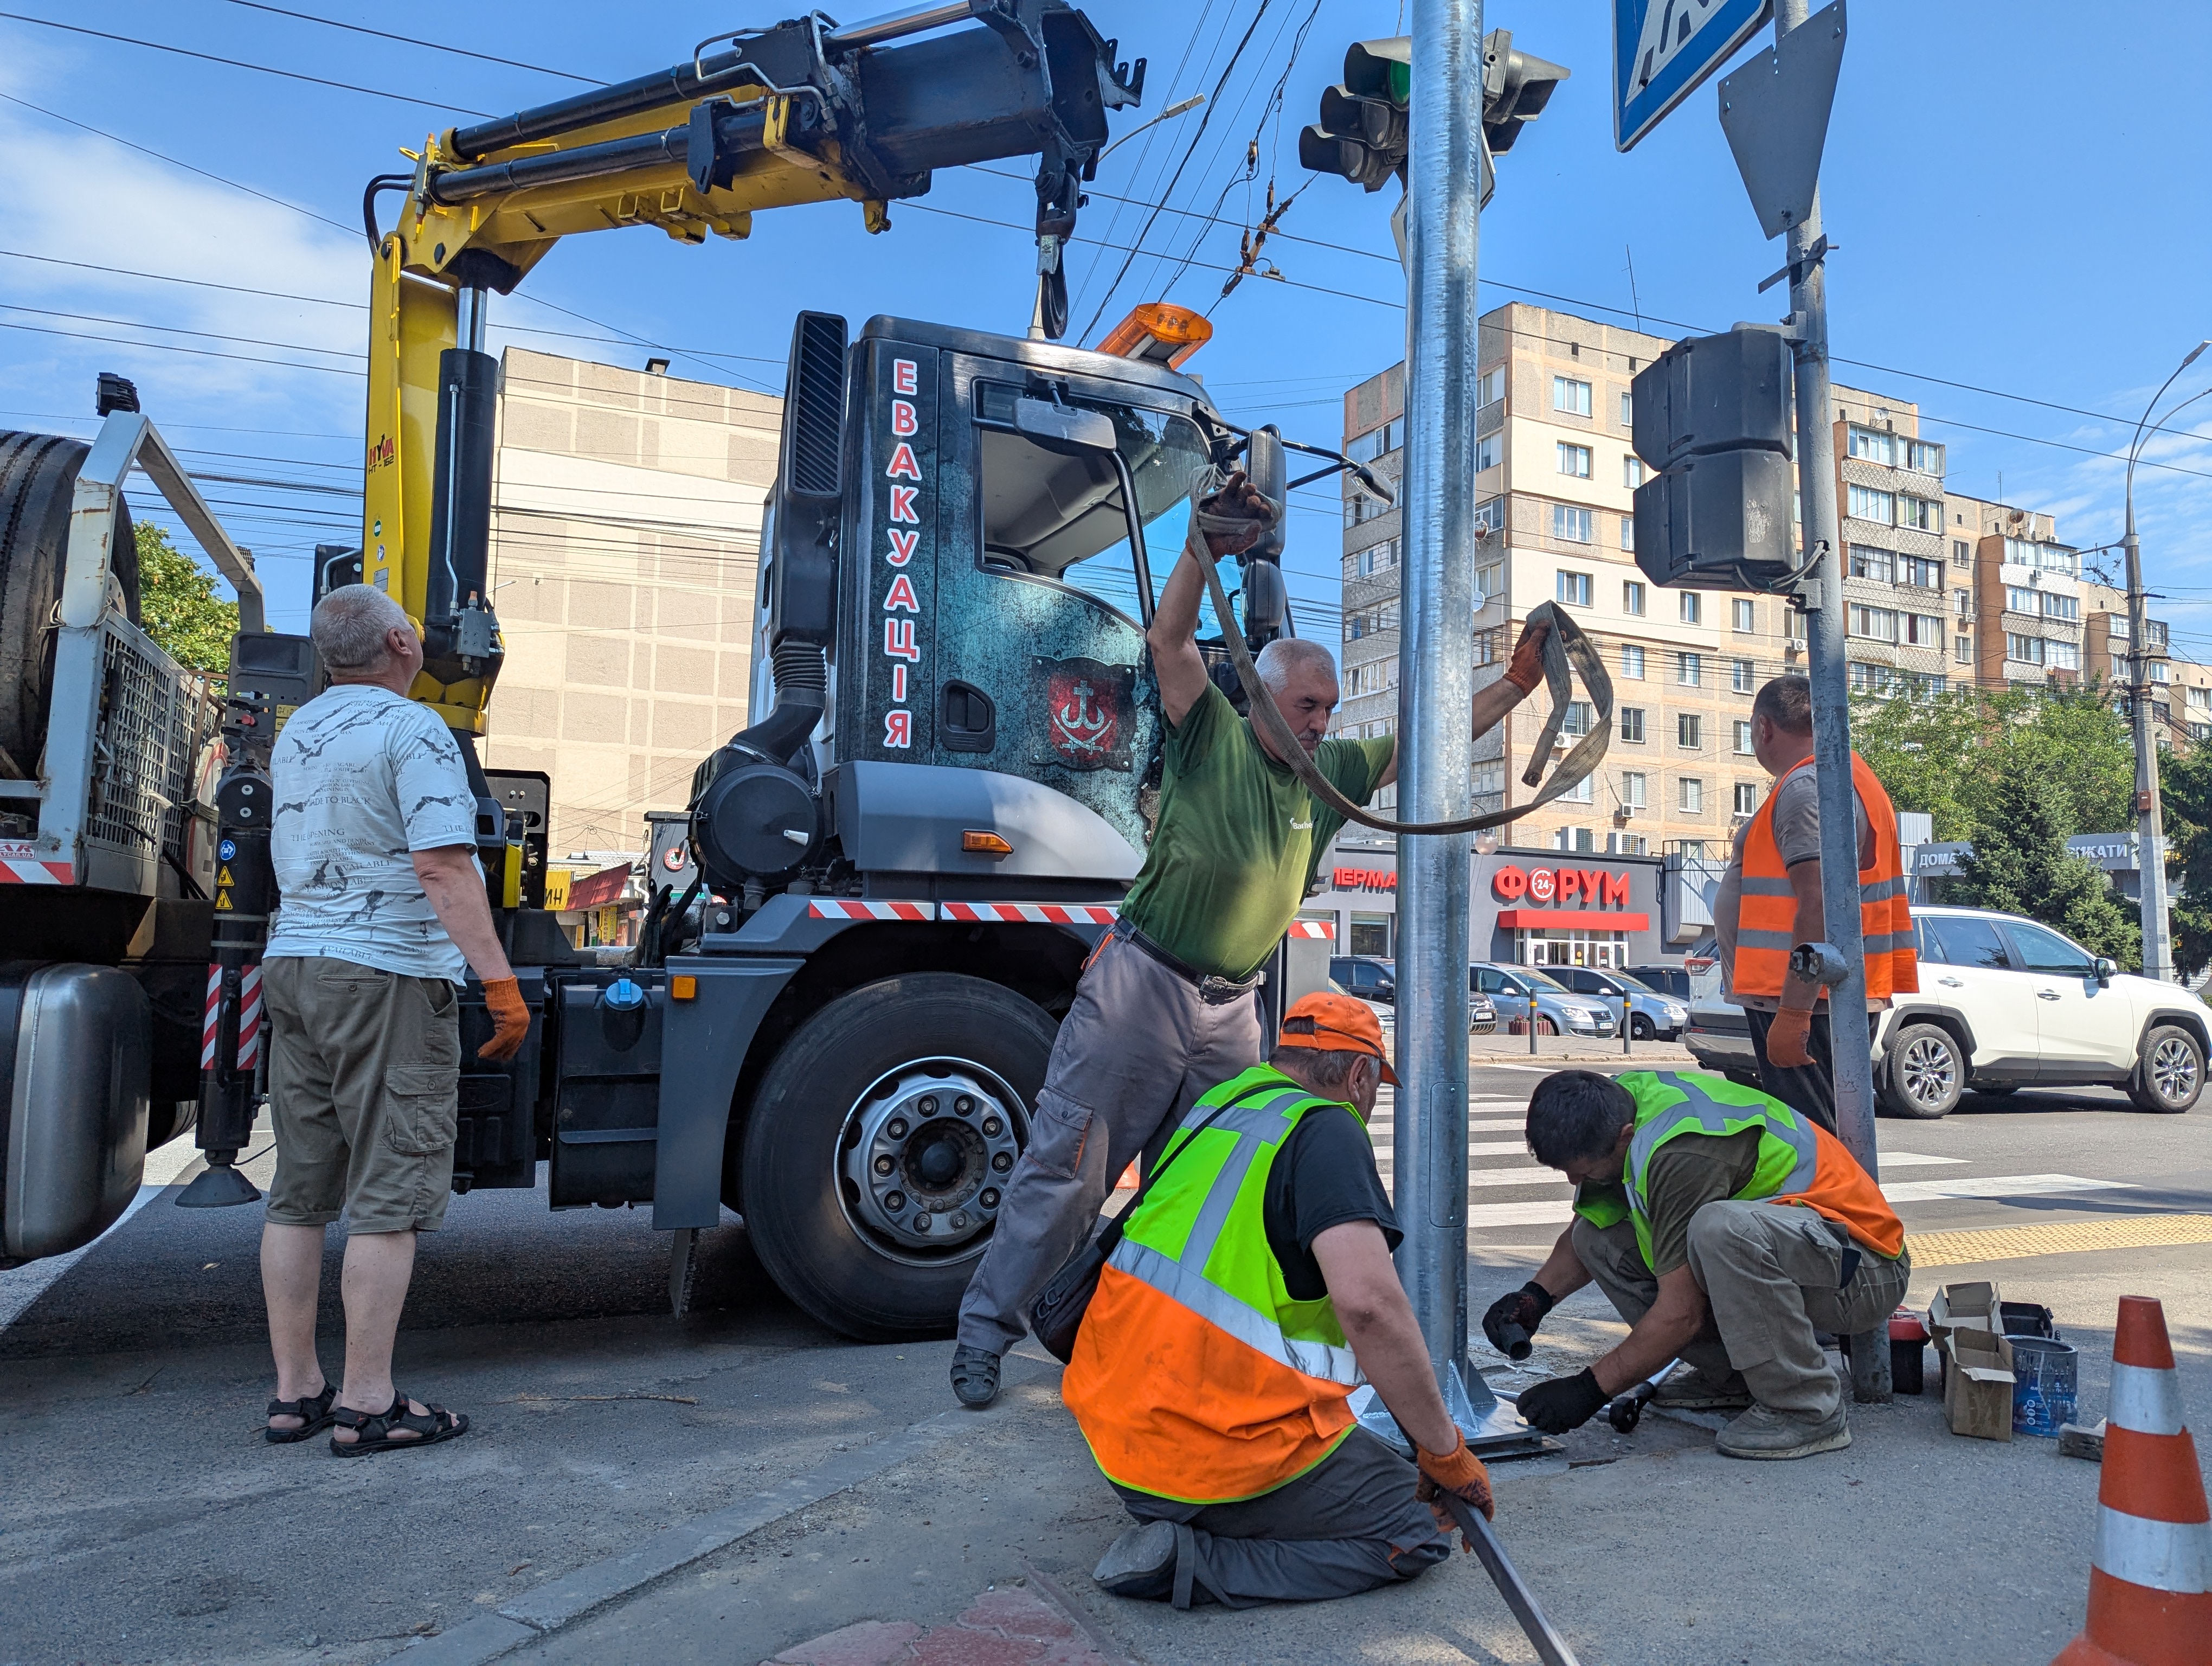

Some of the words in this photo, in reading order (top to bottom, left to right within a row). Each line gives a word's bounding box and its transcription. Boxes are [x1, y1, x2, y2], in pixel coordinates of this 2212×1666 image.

[369, 433, 395, 466] HYVA
[883, 358, 923, 749] ЕВАКУАЦІЯ
[341, 796, 371, 805] BLACK
[1538, 879, 1548, 889] 24
